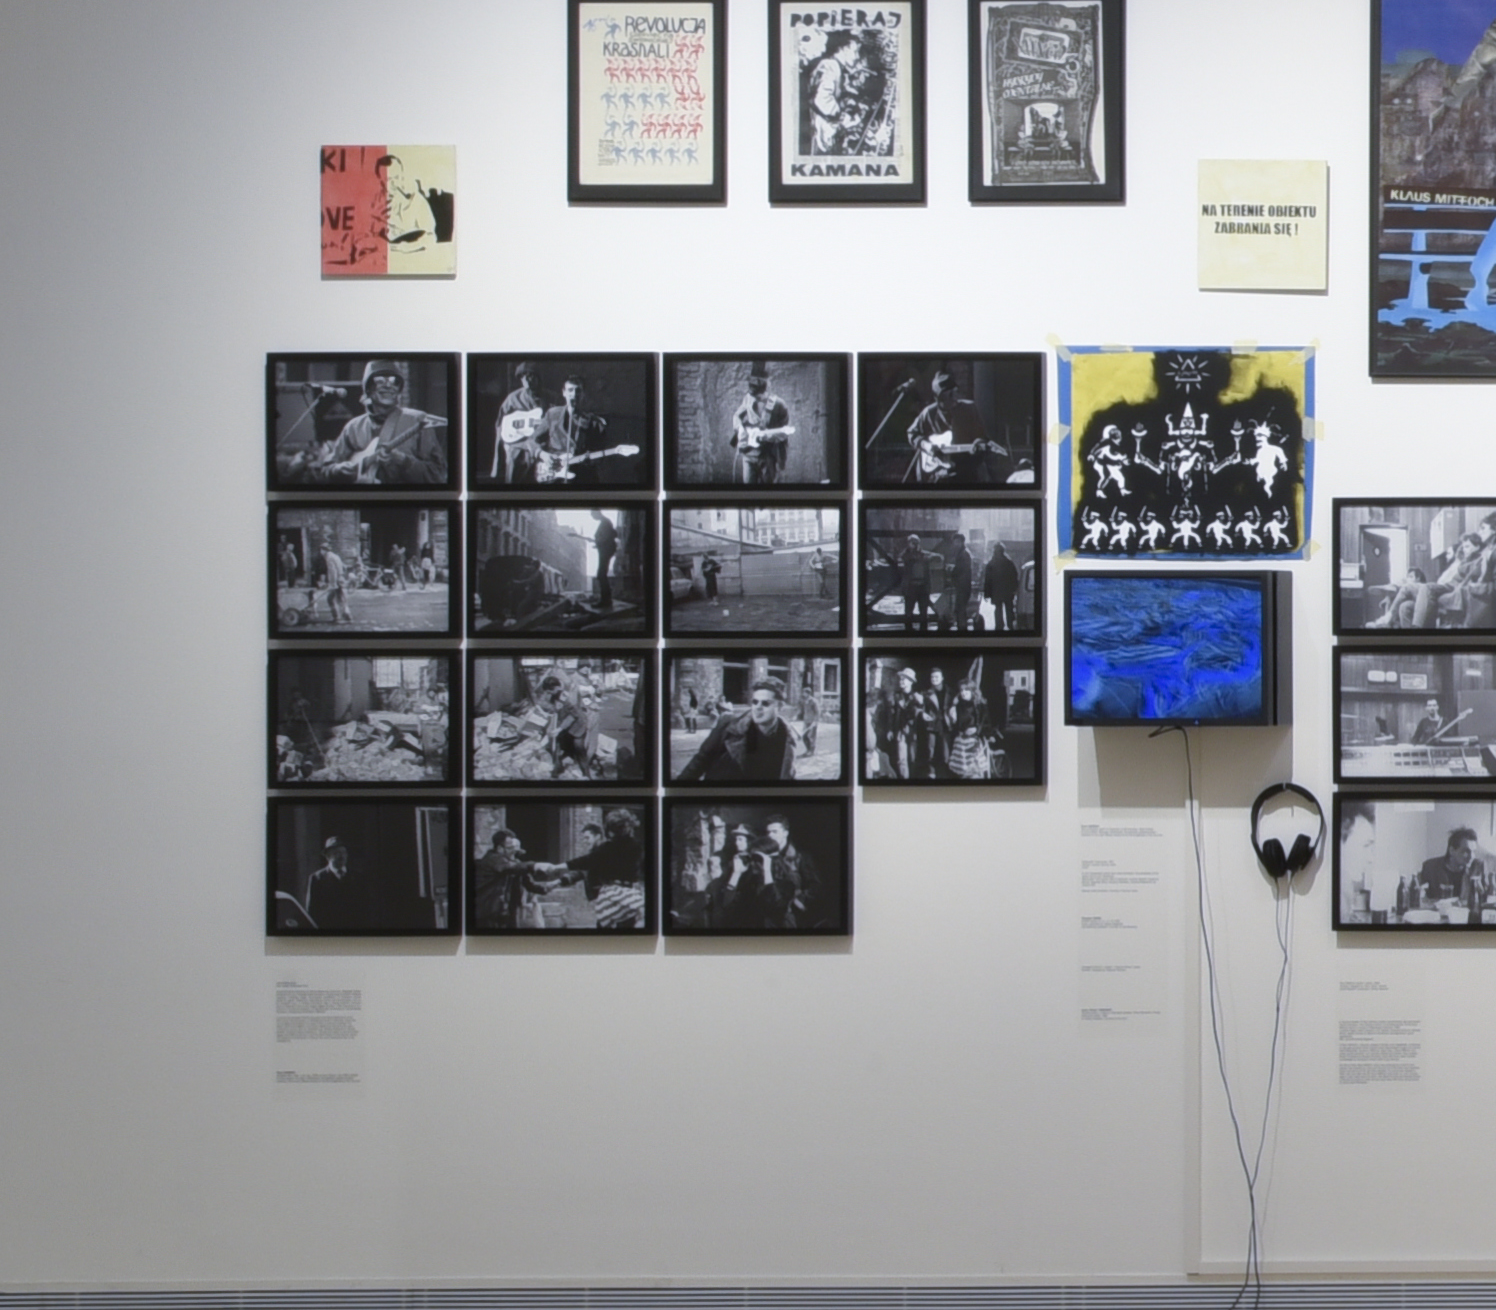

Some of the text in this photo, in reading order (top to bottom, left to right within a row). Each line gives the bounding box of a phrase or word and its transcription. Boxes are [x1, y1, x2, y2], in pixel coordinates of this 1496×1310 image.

[791, 164, 900, 176] KAMANA
[1390, 190, 1431, 202] KLAUS
[1202, 204, 1317, 218] NA TERENIE OBIEKTU
[1214, 221, 1271, 234] ZABRANIA
